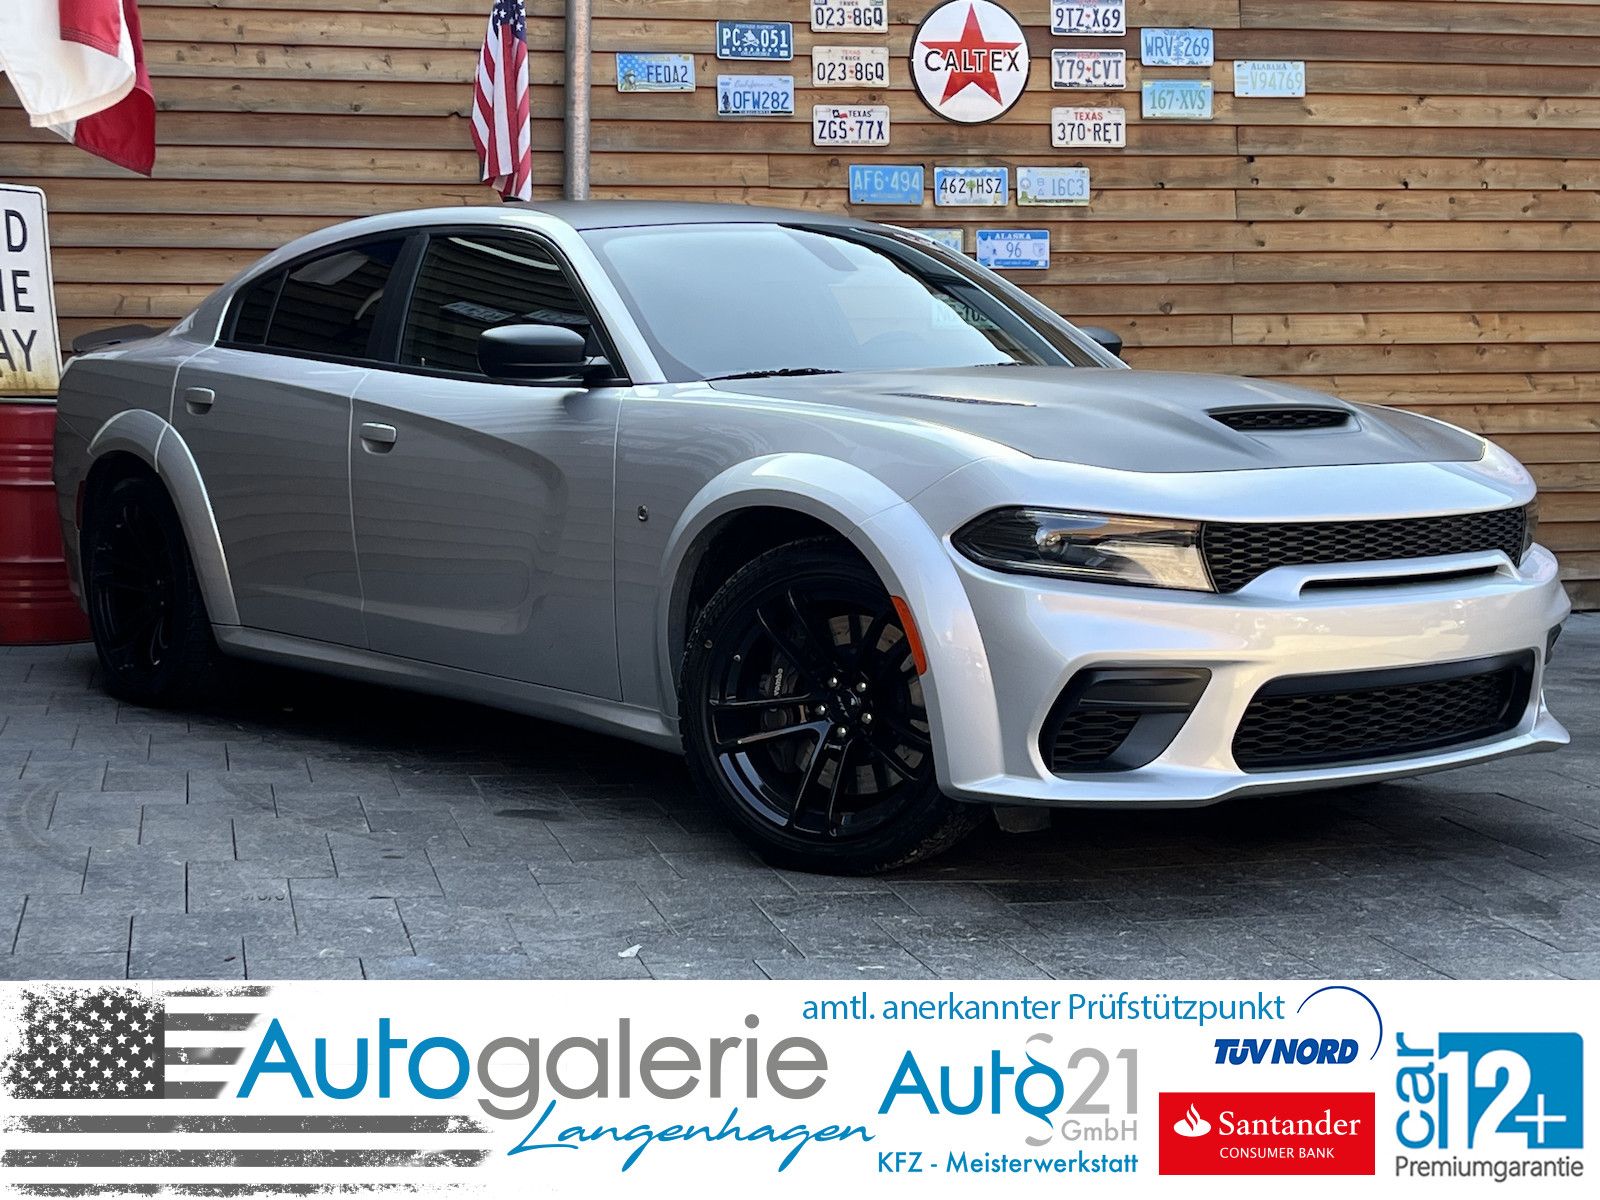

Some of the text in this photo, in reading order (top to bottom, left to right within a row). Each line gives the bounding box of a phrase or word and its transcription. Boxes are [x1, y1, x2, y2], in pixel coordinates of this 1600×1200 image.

[924, 50, 1020, 72] CALTEX
[848, 110, 872, 118] TEXAS
[1074, 112, 1104, 121] TEXAS
[994, 232, 1032, 240] ALASKA
[1006, 241, 1022, 258] 96
